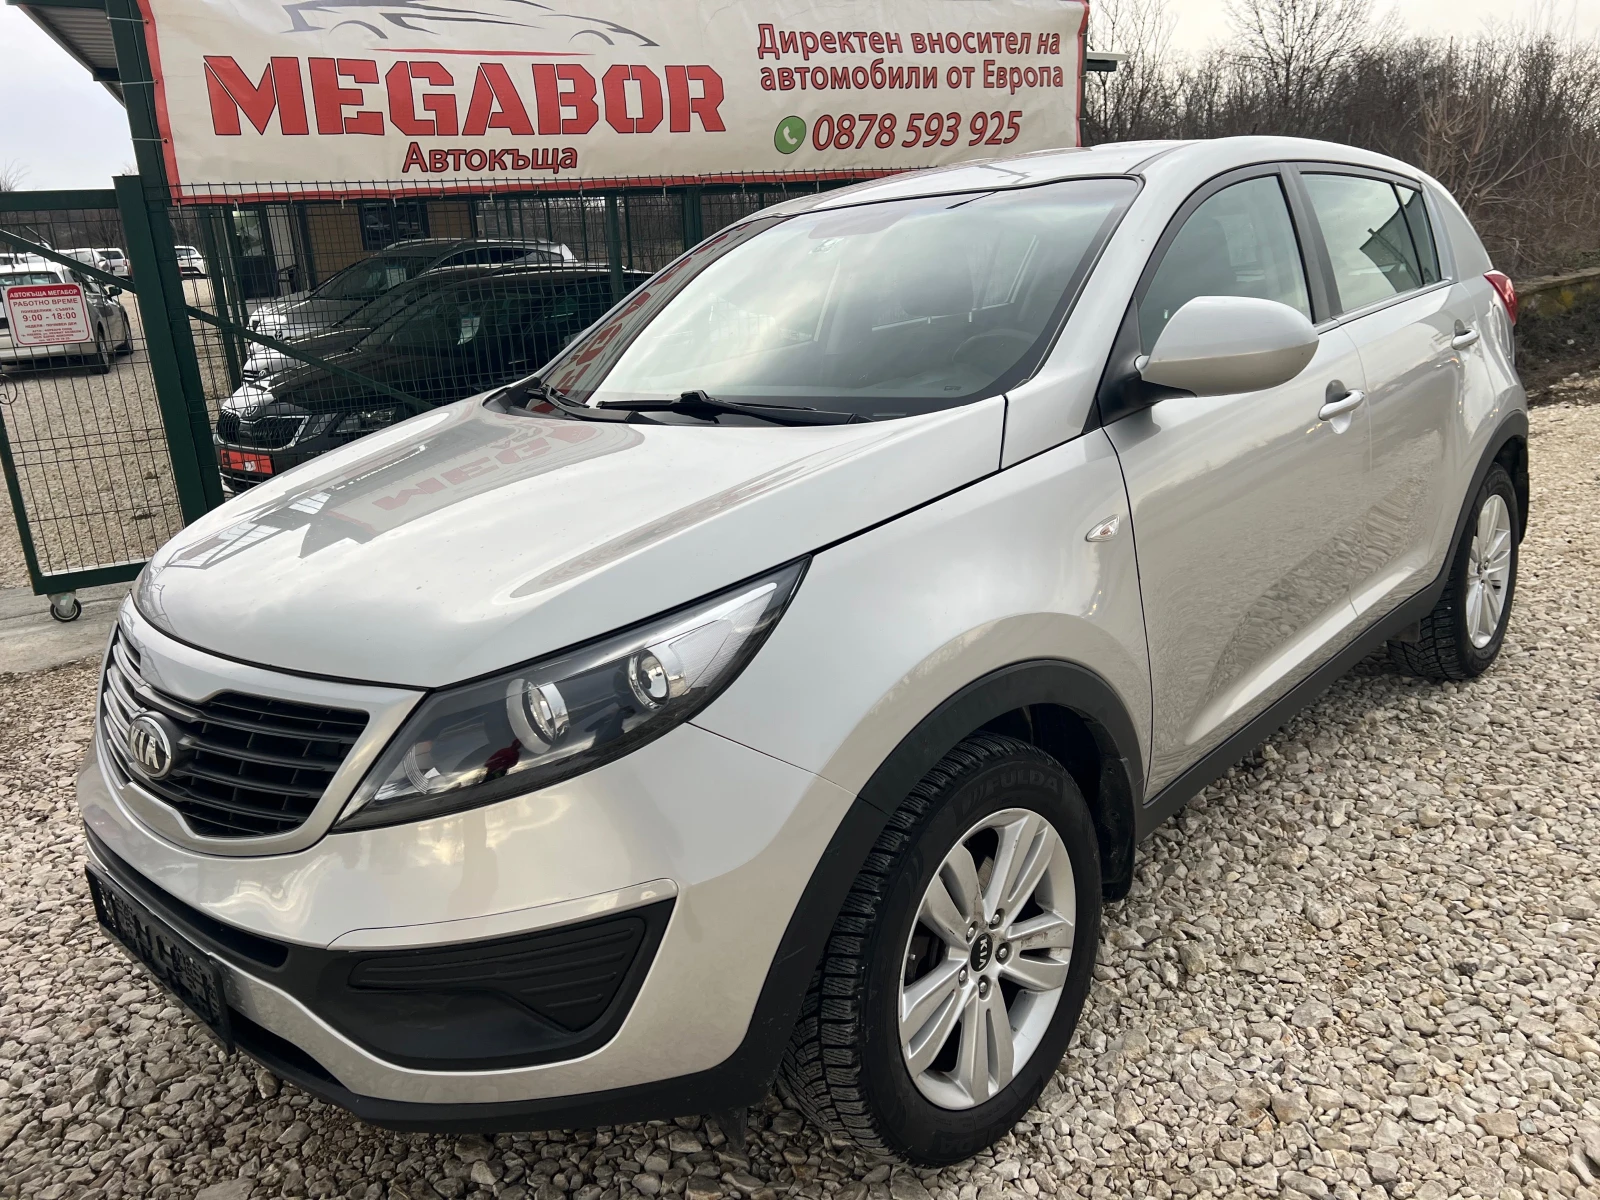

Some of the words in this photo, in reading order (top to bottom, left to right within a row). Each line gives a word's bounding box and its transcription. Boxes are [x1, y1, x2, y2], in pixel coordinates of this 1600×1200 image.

[757, 23, 903, 60] Директен
[911, 31, 1031, 55] вносител
[1037, 31, 1061, 55] на
[760, 58, 938, 91] автомобили
[946, 65, 975, 89] от
[983, 59, 1064, 94] Европа
[203, 55, 726, 136] MEGABOR
[812, 113, 897, 151] 0878
[901, 111, 960, 148] 593
[968, 110, 1022, 147] 925
[402, 141, 578, 174] Автокъща
[13, 299, 50, 307] РАБОТНО
[52, 297, 78, 305] ВРЕМЕ
[22, 314, 43, 322] 9:00
[52, 311, 77, 320] 18:00
[985, 769, 1060, 794] FULDA
[978, 938, 988, 969] KIA
